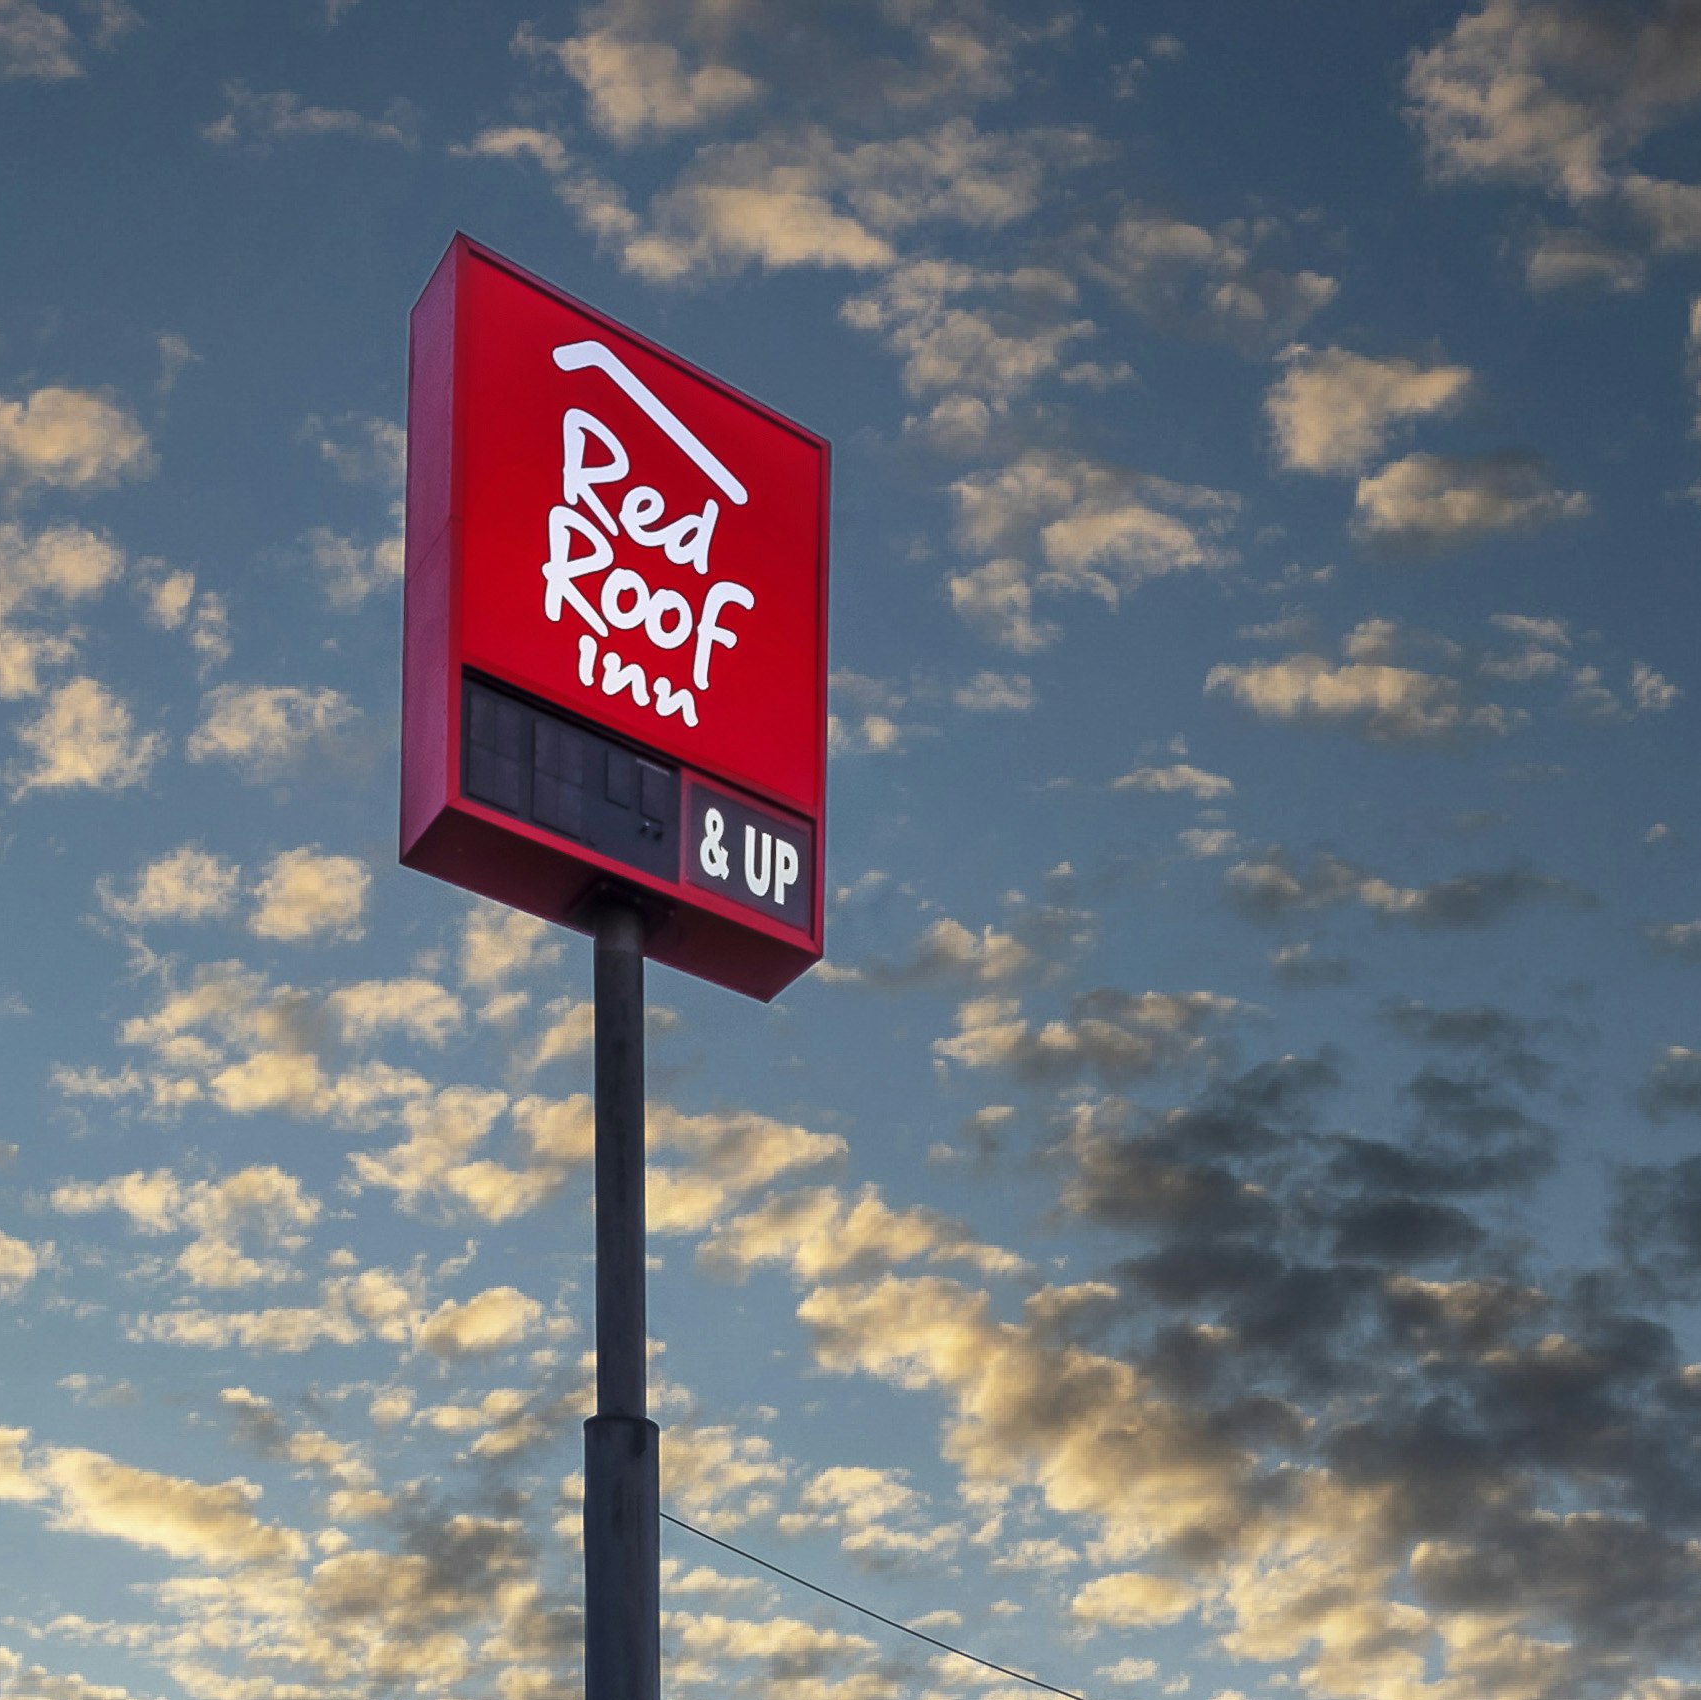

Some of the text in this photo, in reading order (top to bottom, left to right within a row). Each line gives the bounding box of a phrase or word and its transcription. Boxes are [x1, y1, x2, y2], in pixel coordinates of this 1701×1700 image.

[562, 408, 719, 574] Red
[542, 505, 755, 690] Roof
[699, 807, 799, 905] & UP
